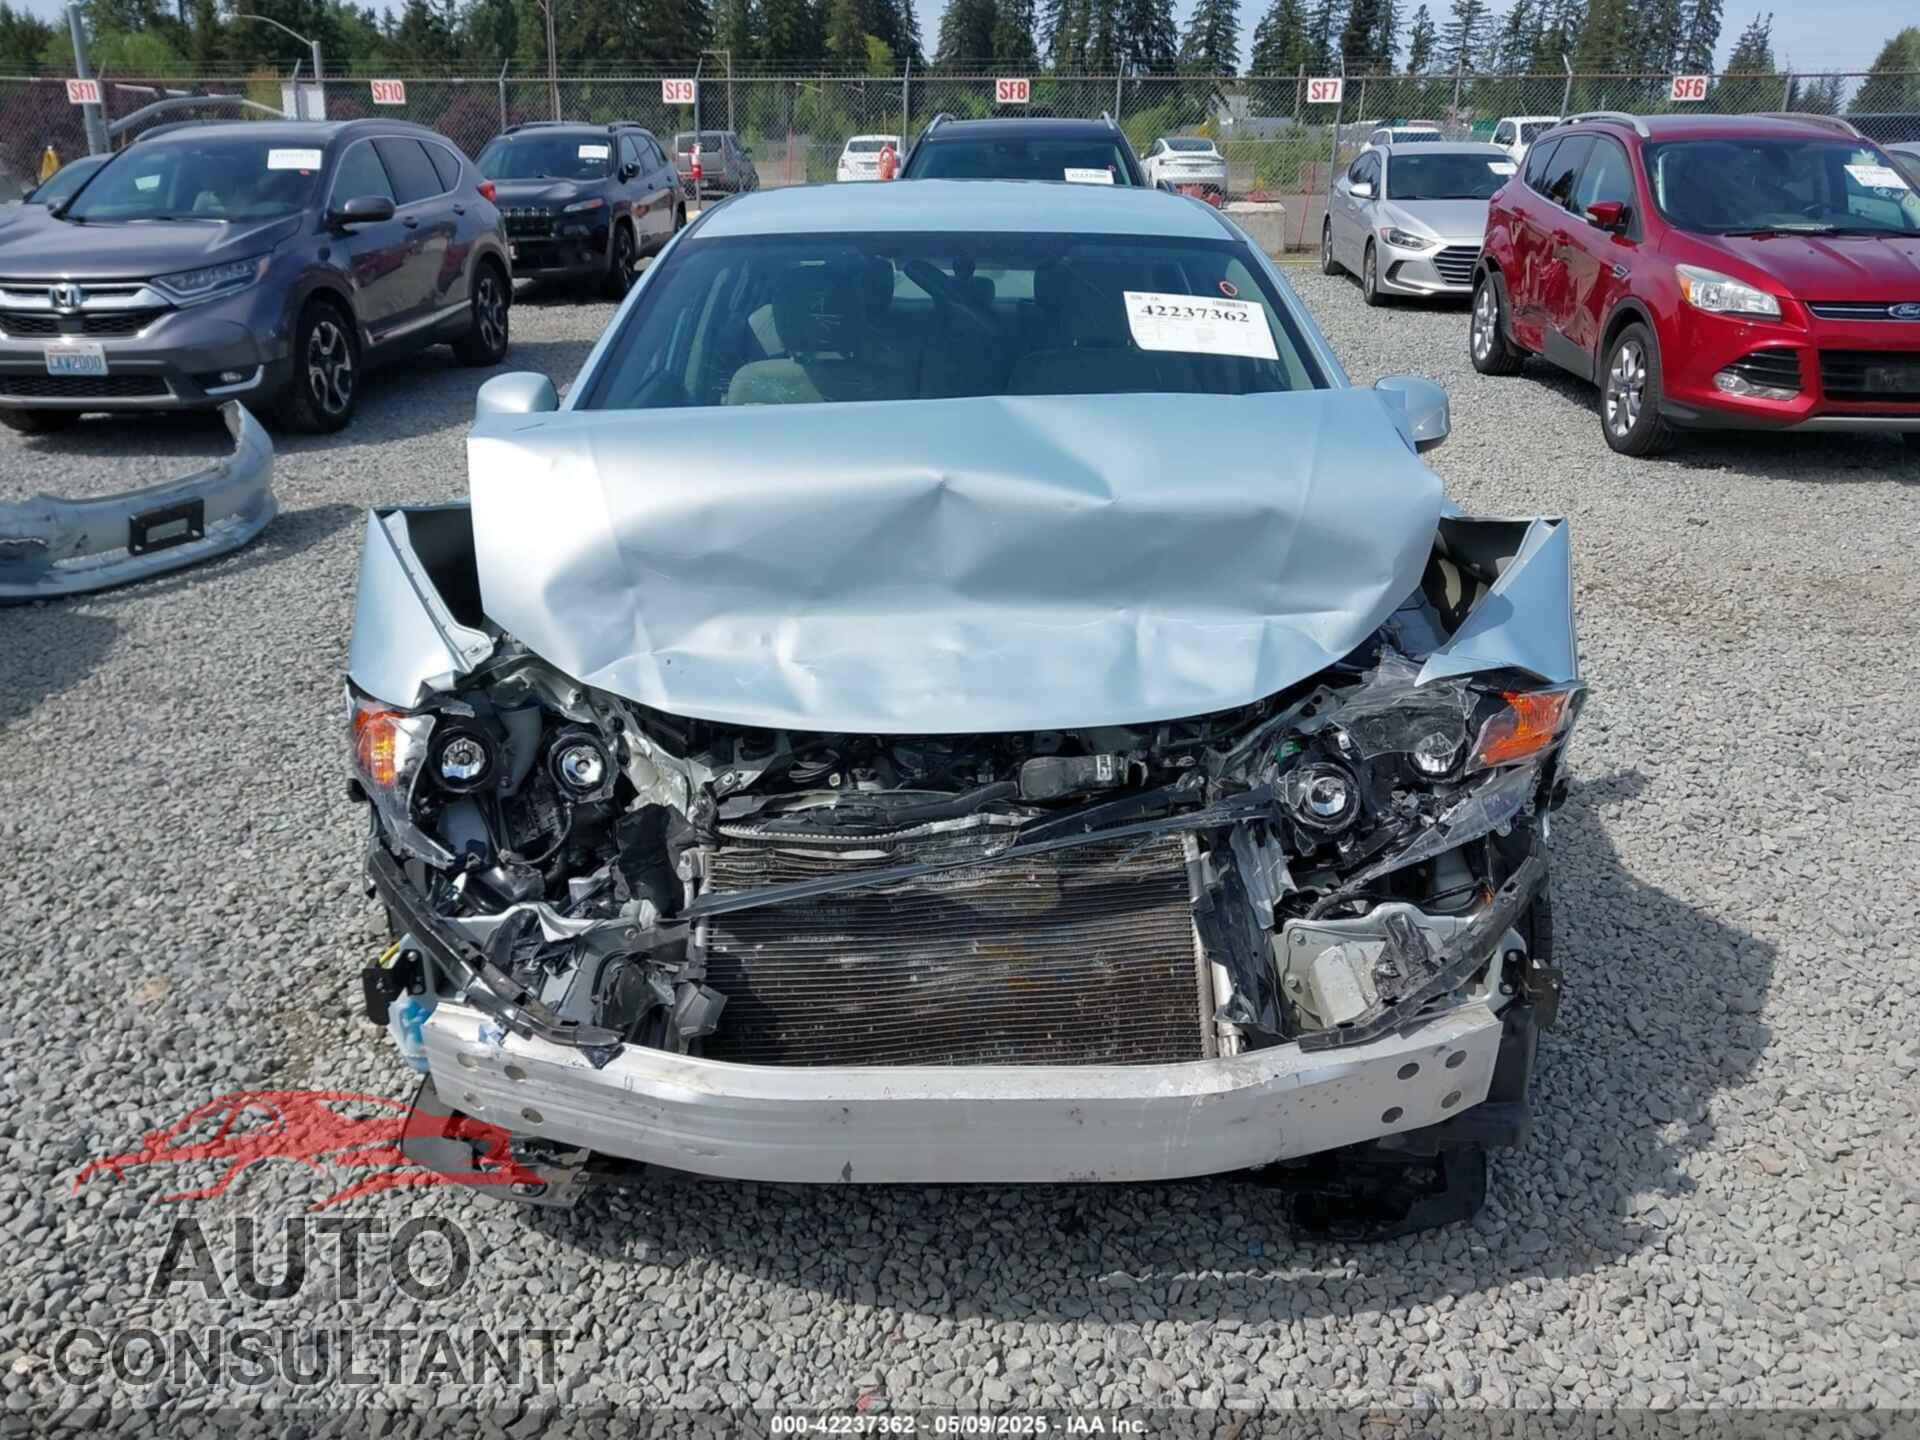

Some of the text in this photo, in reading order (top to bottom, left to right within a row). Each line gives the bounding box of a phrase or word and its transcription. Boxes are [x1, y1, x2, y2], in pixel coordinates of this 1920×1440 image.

[70, 81, 98, 101] SF11
[373, 81, 404, 101] SF10
[665, 81, 693, 101] SF9
[999, 81, 1027, 100] SF8
[1311, 81, 1338, 100] SF7
[1673, 78, 1705, 98] SF6
[1140, 304, 1250, 323] 42237362
